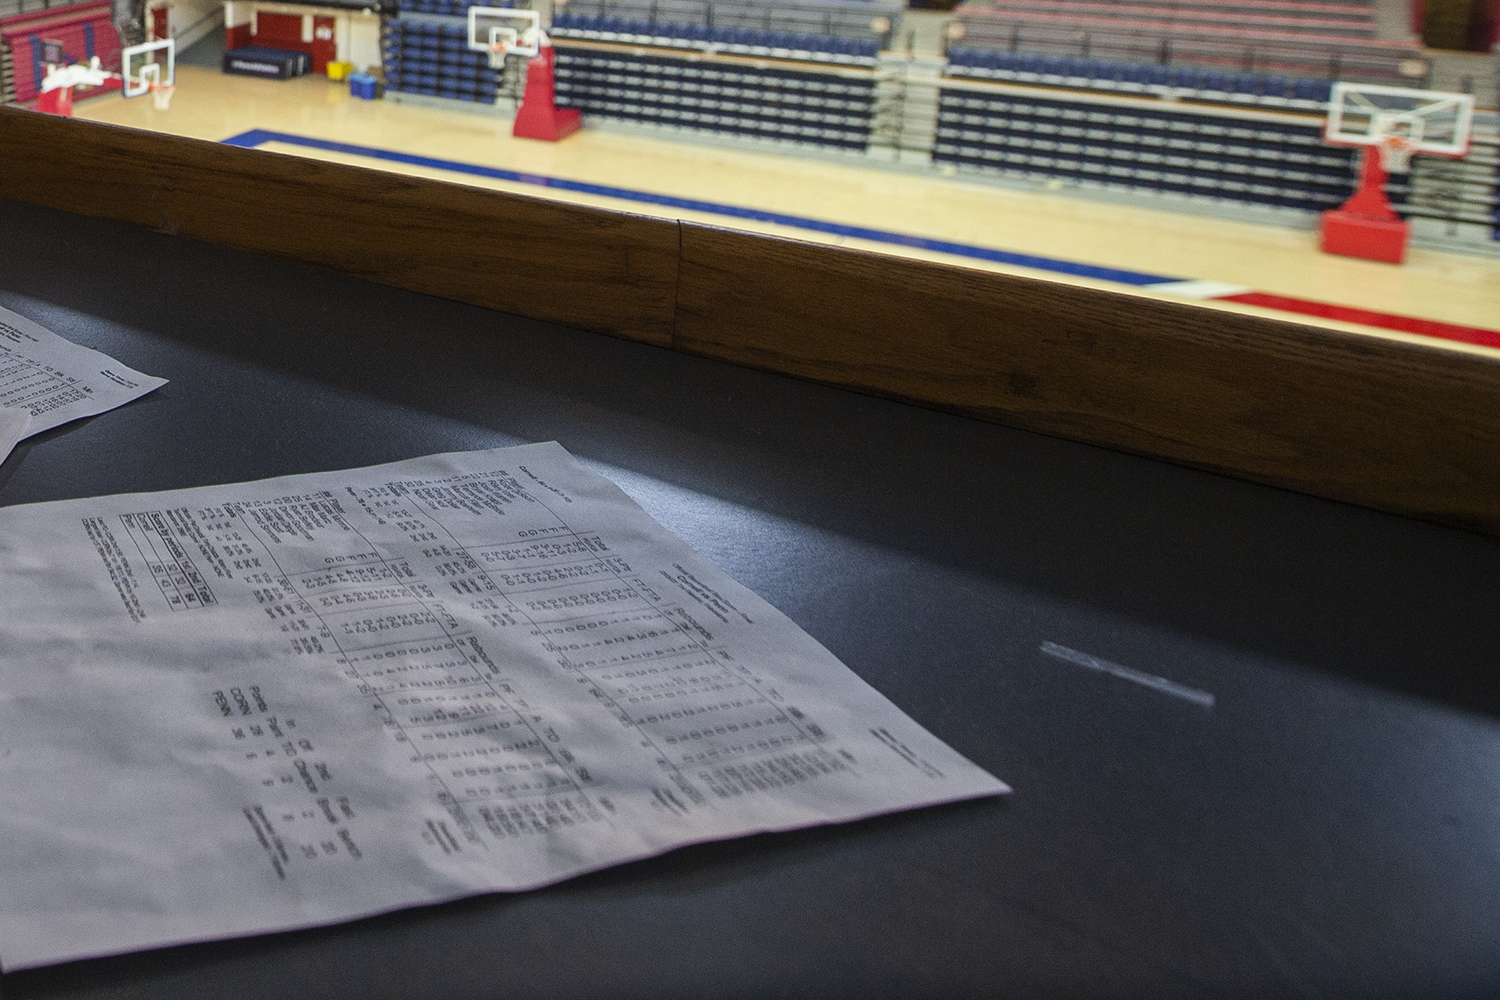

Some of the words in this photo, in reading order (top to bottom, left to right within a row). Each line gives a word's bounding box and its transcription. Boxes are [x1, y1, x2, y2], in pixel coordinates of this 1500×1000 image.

[151, 513, 165, 529] Score
[163, 537, 184, 559] periods
[198, 586, 216, 604] Total
